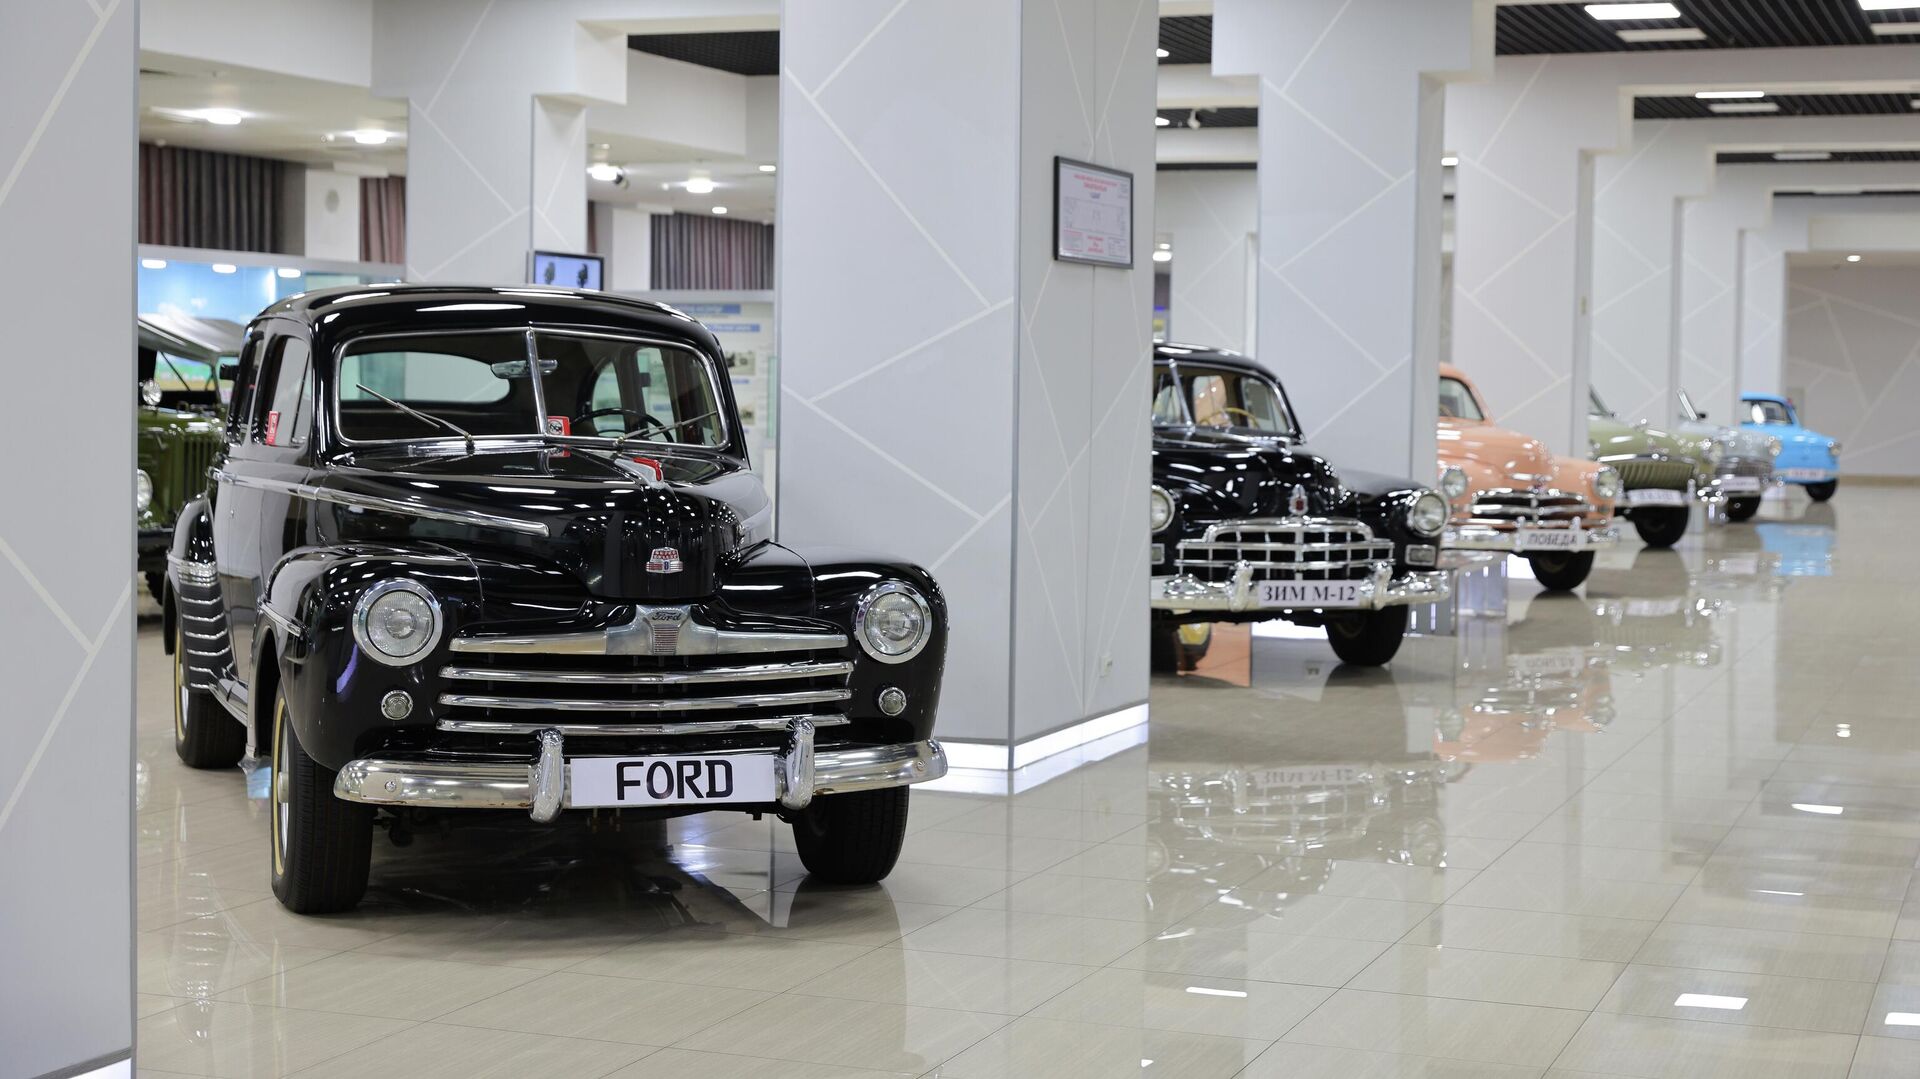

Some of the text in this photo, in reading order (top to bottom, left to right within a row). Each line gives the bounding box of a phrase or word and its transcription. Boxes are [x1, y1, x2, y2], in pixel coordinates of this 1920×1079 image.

[1264, 585, 1355, 601] ЗИМ М-12
[652, 611, 681, 621] Ford
[616, 759, 734, 801] FORD
